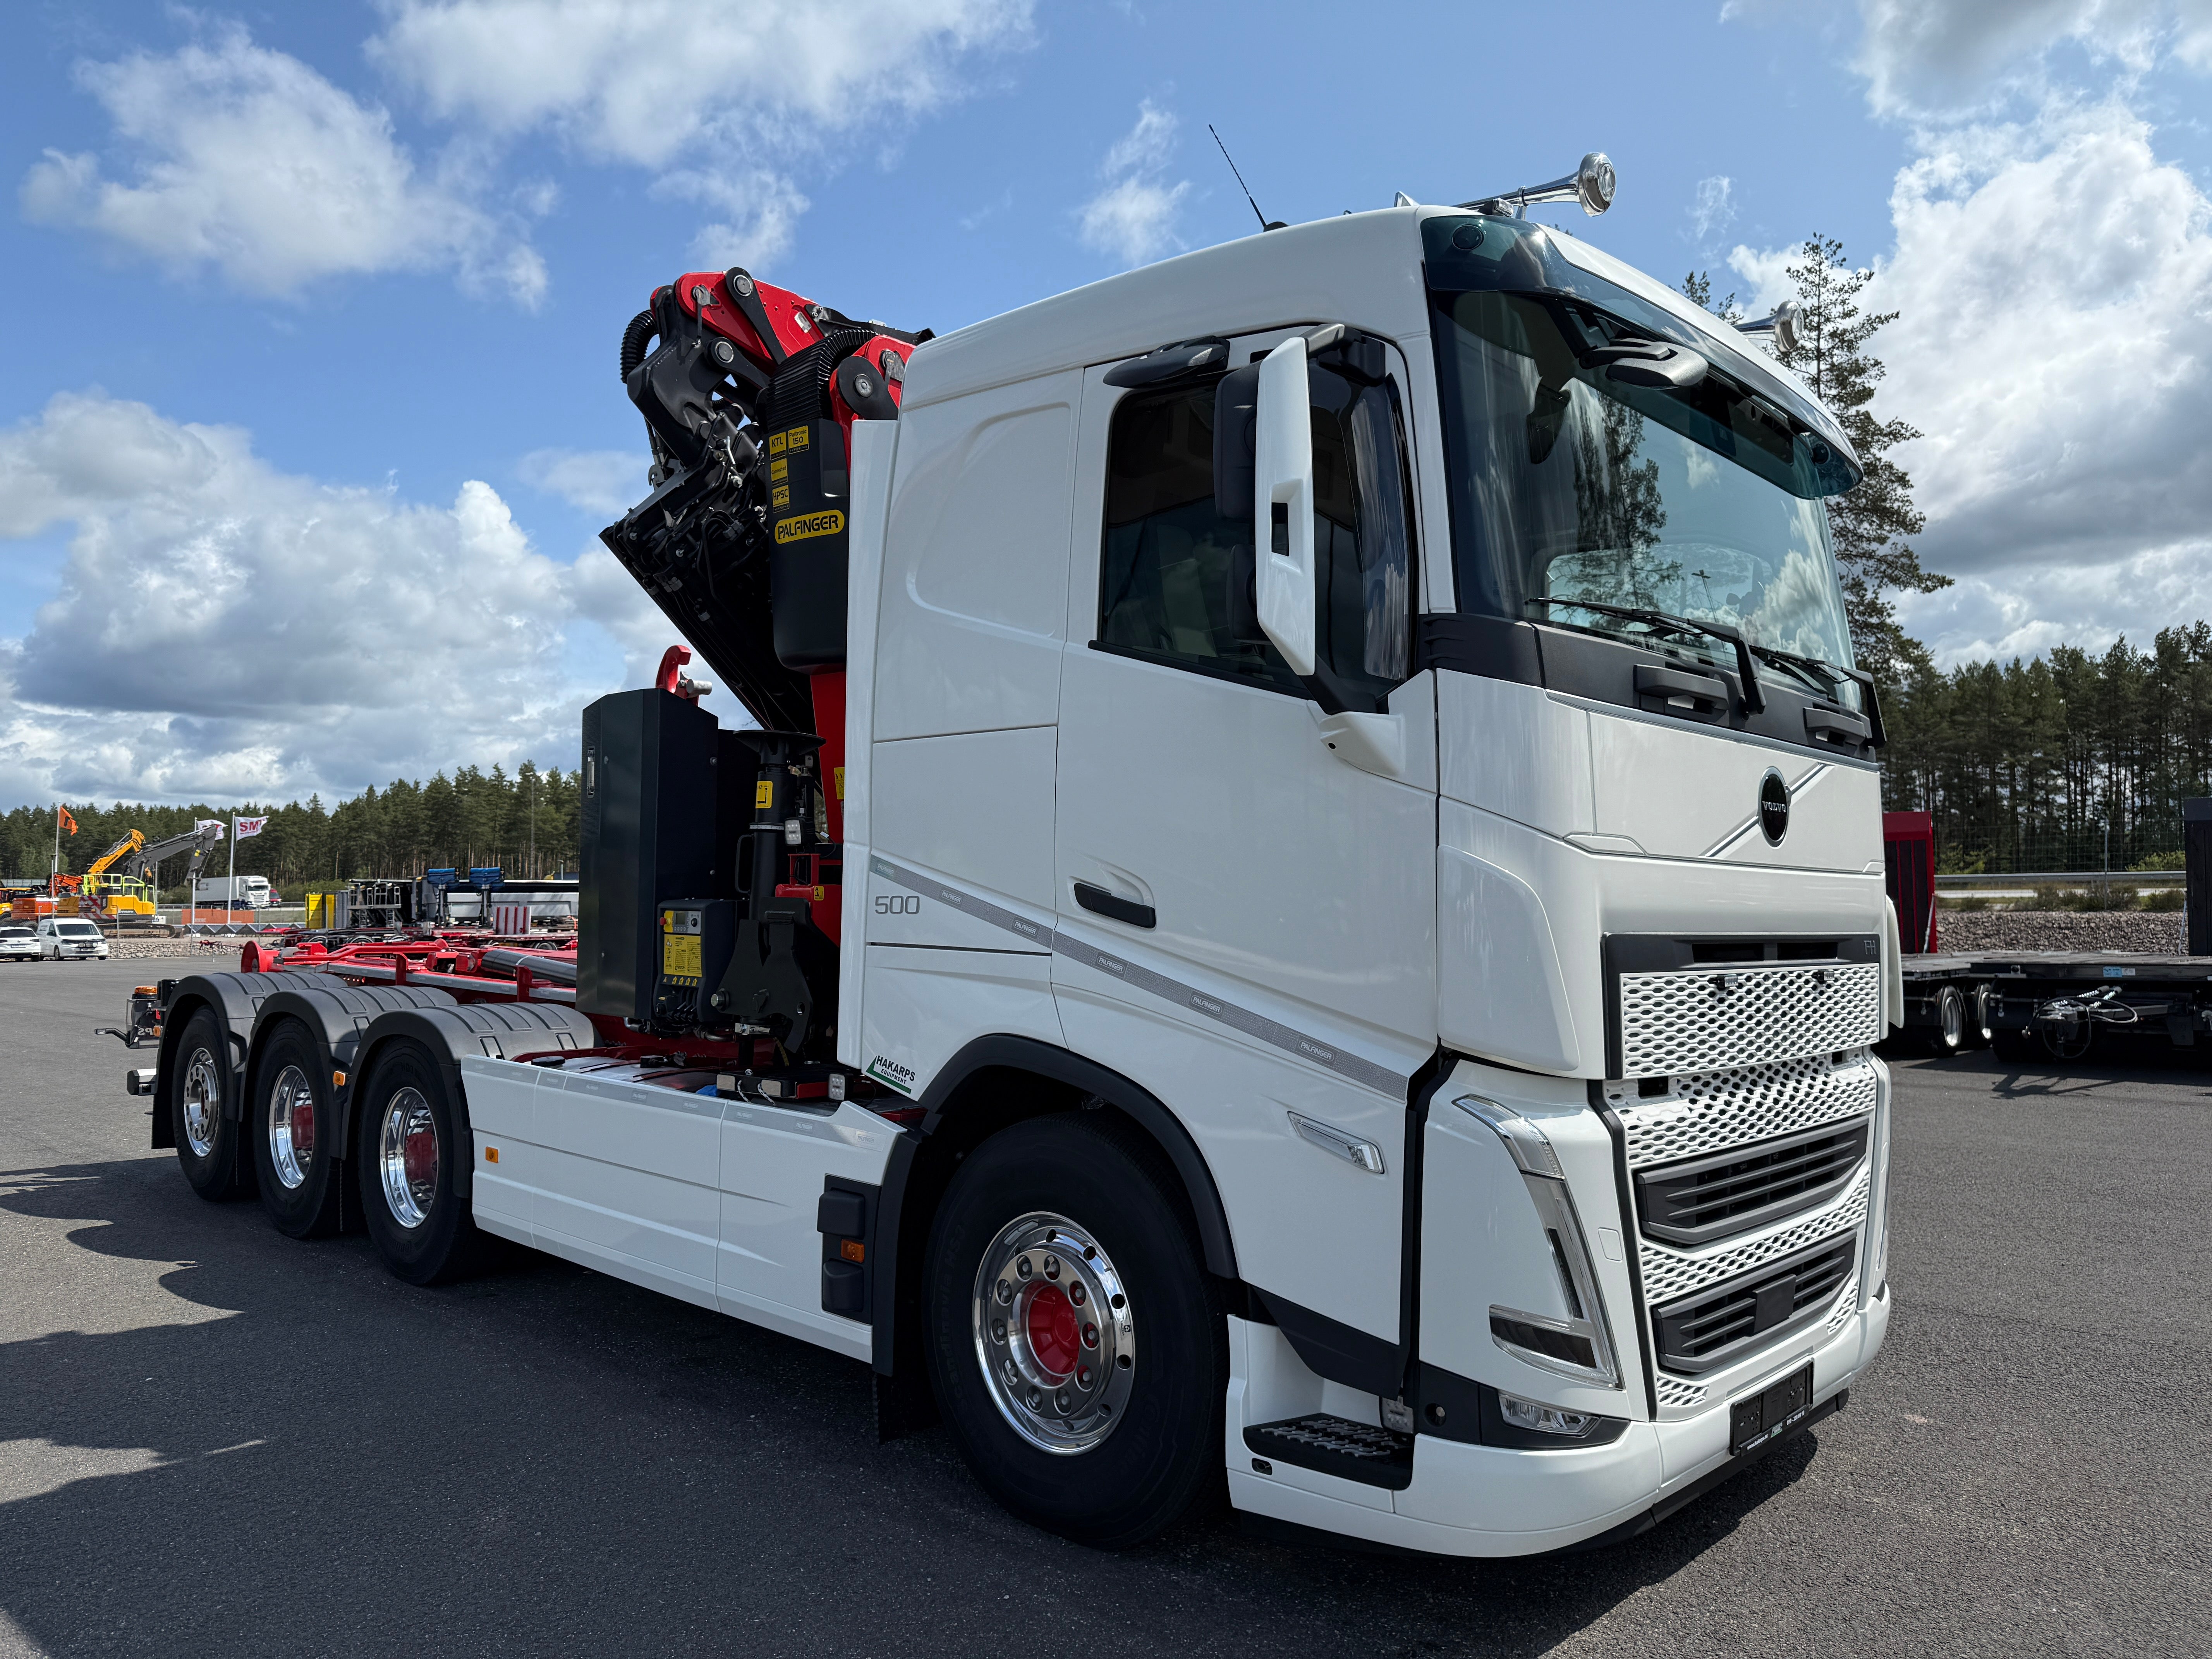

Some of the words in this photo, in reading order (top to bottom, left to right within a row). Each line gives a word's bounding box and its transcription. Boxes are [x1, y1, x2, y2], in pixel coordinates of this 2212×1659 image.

[772, 437, 783, 448] KTL
[793, 436, 804, 445] 150
[771, 466, 787, 474] Connected
[773, 489, 788, 501] HPSC
[778, 514, 839, 539] PALFINGER
[1762, 801, 1786, 813] VOLVO
[875, 895, 920, 914] 500
[941, 891, 961, 903] PALFINGER
[1015, 921, 1036, 934] PALFINGER
[1864, 940, 1876, 955] FH
[1099, 957, 1123, 972] PALFINGER
[1193, 996, 1220, 1012] PALFINGER
[1300, 1042, 1332, 1060] PALFINGER
[876, 1055, 915, 1082] HAKARPS
[881, 1069, 907, 1084] EQUIPMENT
